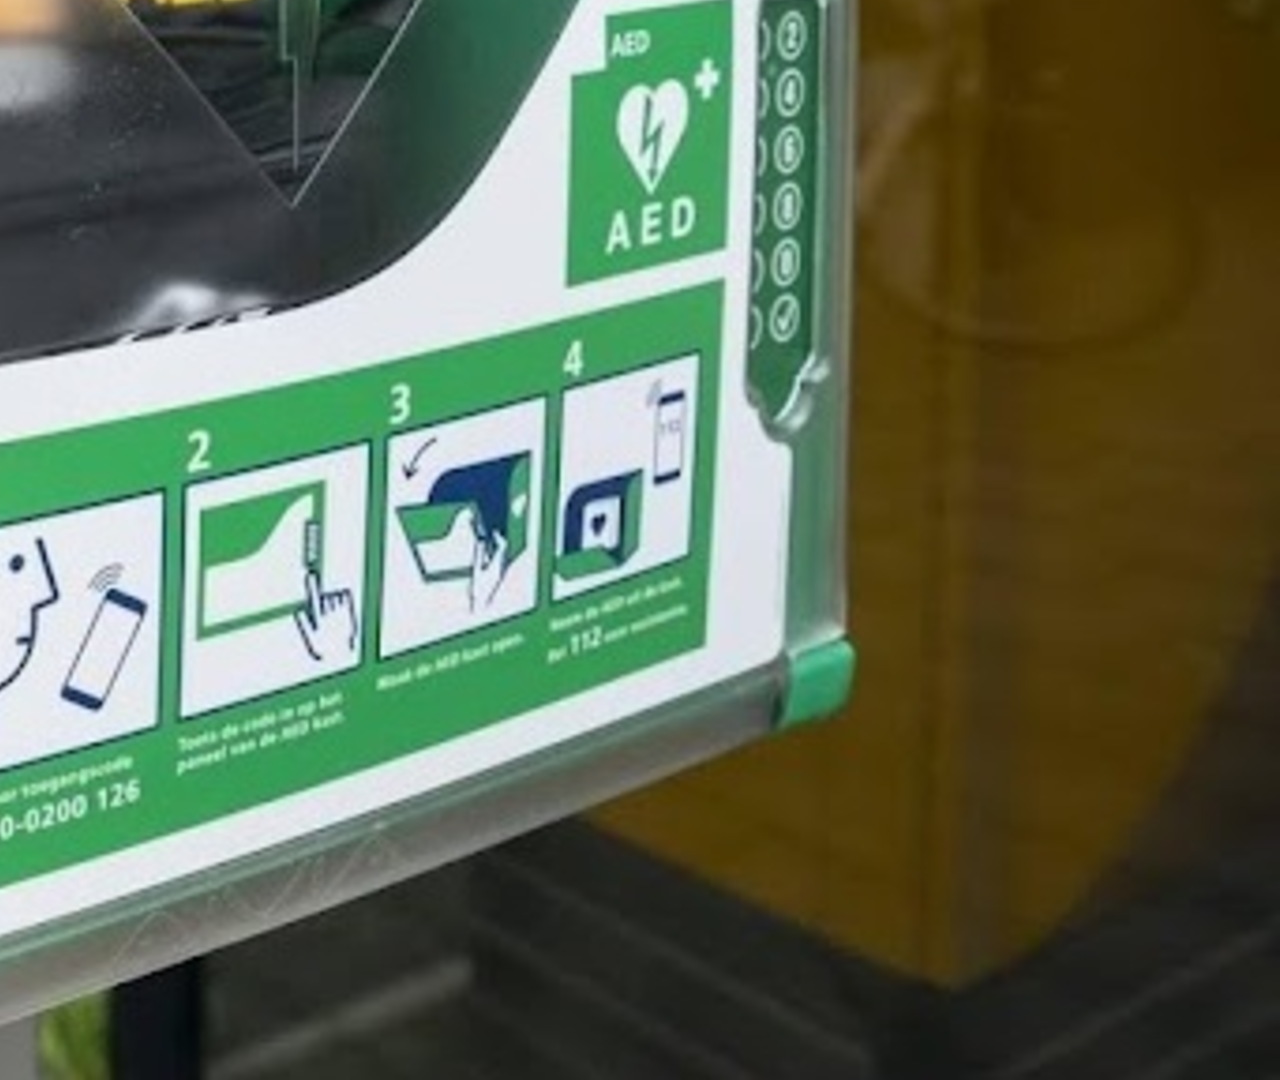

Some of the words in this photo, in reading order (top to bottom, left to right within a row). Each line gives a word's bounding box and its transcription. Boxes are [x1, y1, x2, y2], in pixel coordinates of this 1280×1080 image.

[611, 29, 651, 58] AED
[605, 196, 697, 254] AED
[563, 340, 584, 377] 4
[390, 384, 411, 422] 3
[187, 430, 211, 473] 2
[570, 625, 602, 655] 112
[97, 778, 140, 810] 126
